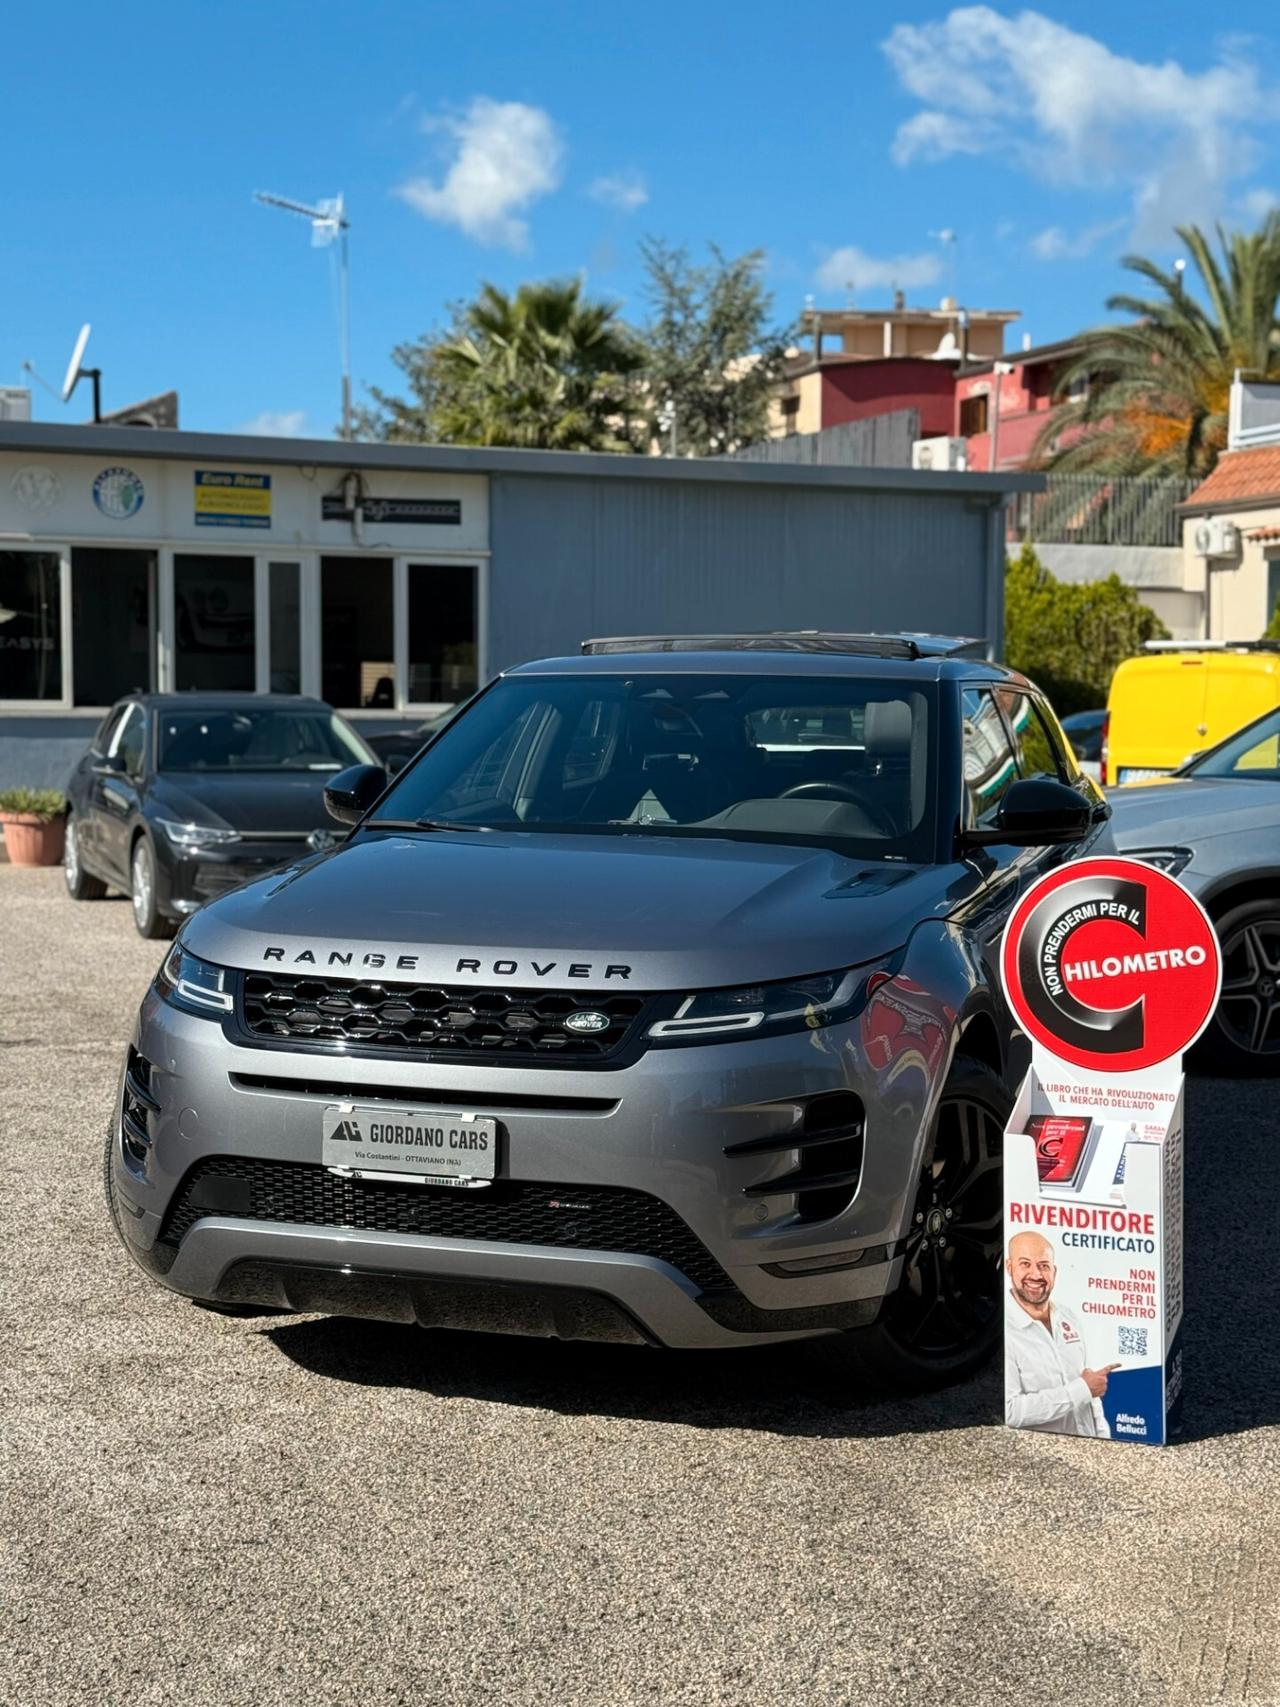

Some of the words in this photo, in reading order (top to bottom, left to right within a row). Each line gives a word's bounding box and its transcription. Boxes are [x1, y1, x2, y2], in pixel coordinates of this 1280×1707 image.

[1100, 902, 1128, 918] PER
[1128, 908, 1140, 925] IL
[1043, 903, 1097, 964] PRENDERMI
[262, 947, 420, 970] RANGE
[455, 957, 633, 980] ROVER
[1044, 967, 1064, 996] NON
[1046, 1083, 1072, 1094] LIBRO
[1073, 1085, 1089, 1096] CHE
[1091, 1087, 1104, 1097] HA
[1107, 1088, 1176, 1103] RIVOLUZIONATO
[1058, 1095, 1067, 1103] IL
[1070, 1095, 1109, 1107] MERCATO
[1111, 1098, 1155, 1111] DELL'AUTO
[370, 1123, 444, 1148] GIORDANO
[449, 1129, 488, 1151] CARS
[355, 1151, 366, 1159] Via
[366, 1151, 400, 1161] Costantini
[405, 1155, 445, 1165] OTTAVIANO
[424, 1177, 453, 1186] GIORDANO
[454, 1179, 469, 1187] CARS
[1010, 1202, 1155, 1235] RIVENDITORE
[1062, 1232, 1155, 1254] CERTIFICATO
[1129, 1268, 1156, 1282] NON
[1088, 1277, 1156, 1294] PRENDERMI
[1122, 1293, 1143, 1306] PER
[1146, 1295, 1156, 1307] IL
[1081, 1302, 1156, 1319] CHILOMETRO
[1116, 1413, 1146, 1425] Alfredo
[1116, 1423, 1147, 1436] Bellucci
